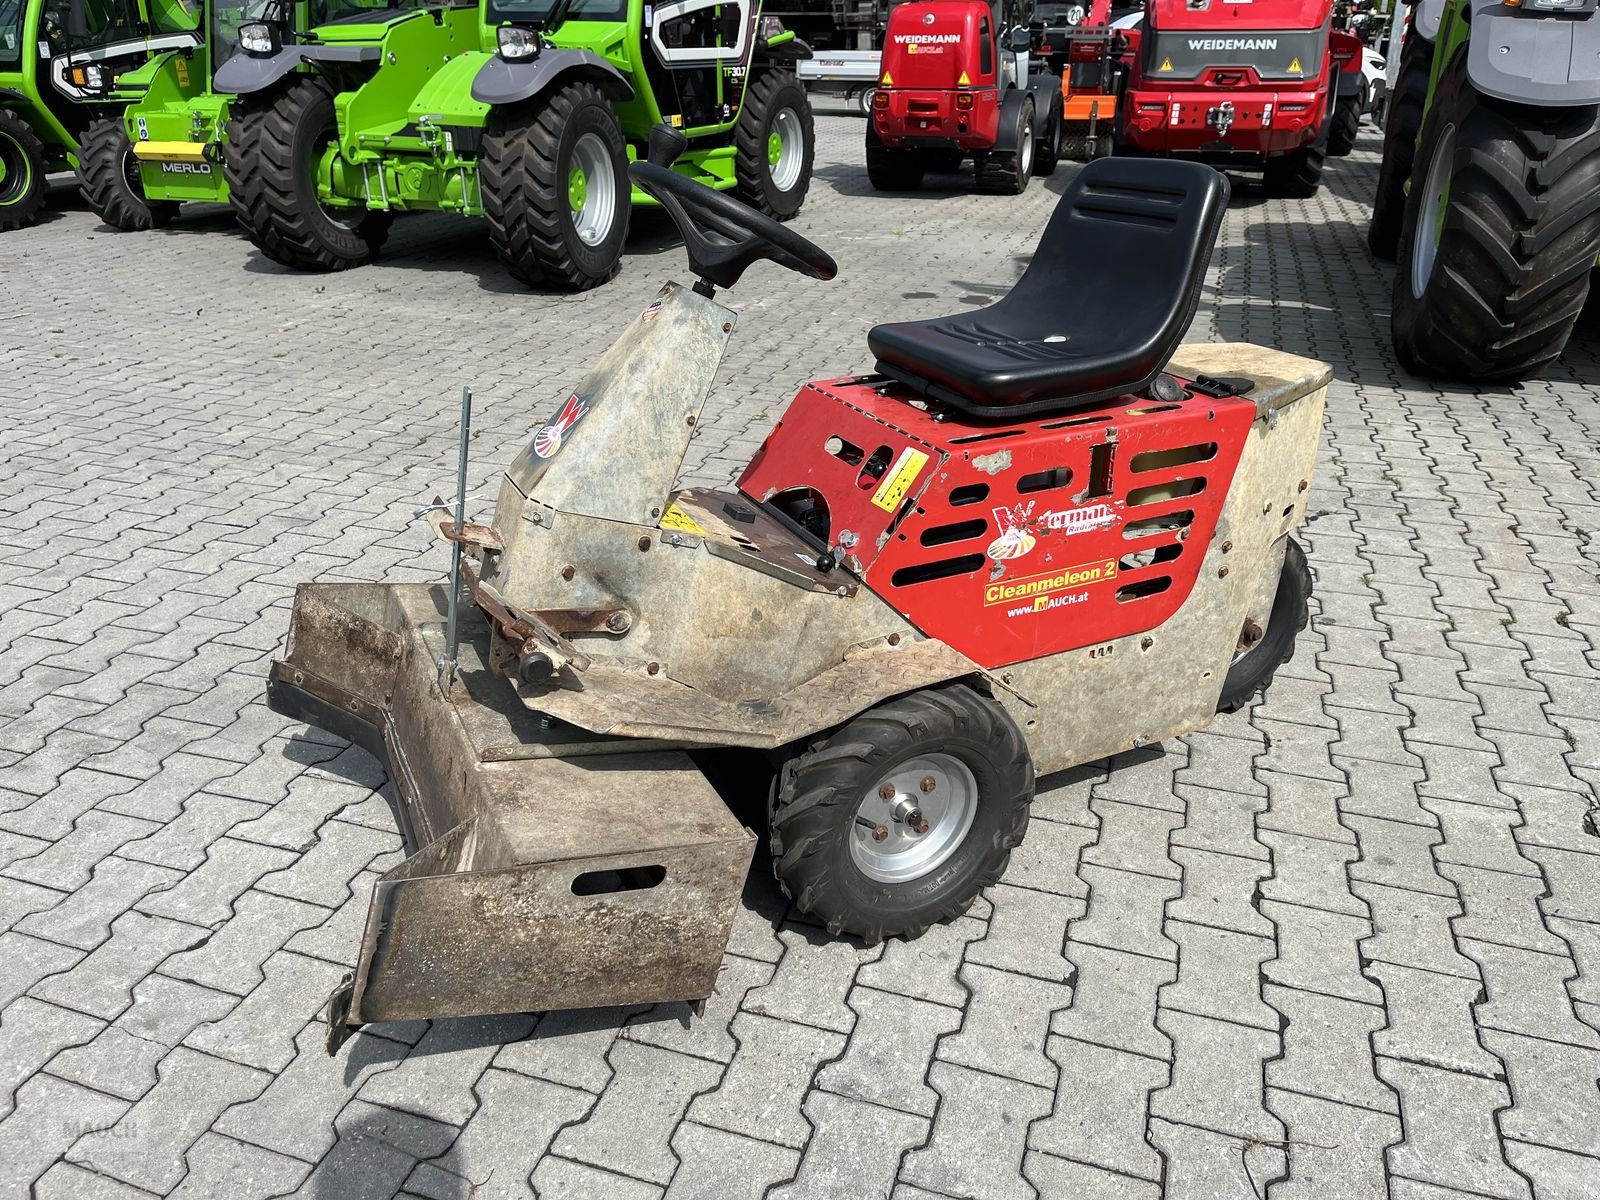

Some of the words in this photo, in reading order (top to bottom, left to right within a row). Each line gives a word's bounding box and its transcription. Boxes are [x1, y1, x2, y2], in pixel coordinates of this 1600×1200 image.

[893, 34, 961, 44] WEIDEMANN
[1187, 39, 1278, 50] WEIDEMANN
[162, 162, 212, 174] MERLO
[986, 567, 1101, 602] Cleanmeleon
[1103, 561, 1116, 577] 2
[1007, 591, 1089, 618] www.MAUCH.at
